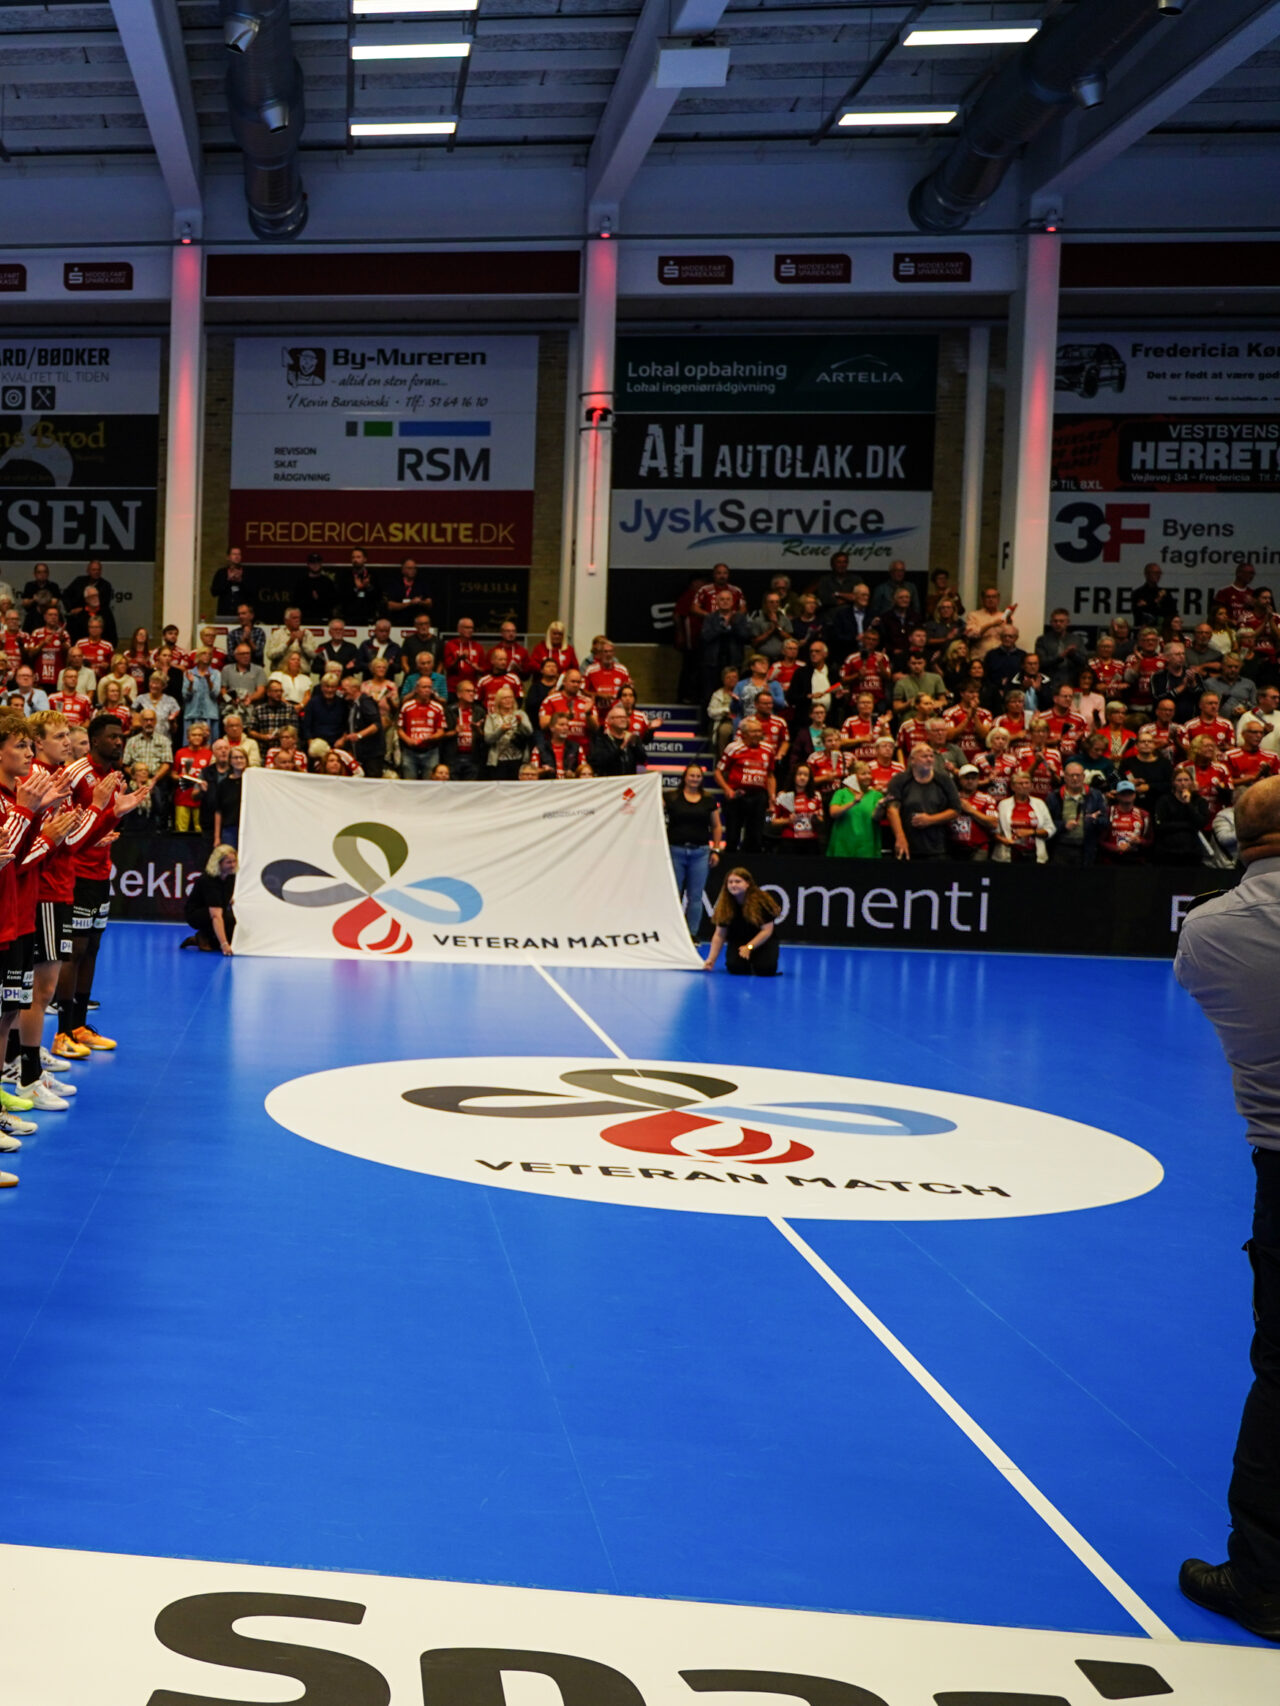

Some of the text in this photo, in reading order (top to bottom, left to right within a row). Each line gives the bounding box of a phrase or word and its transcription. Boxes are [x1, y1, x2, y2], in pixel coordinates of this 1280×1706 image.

[1131, 343, 1239, 358] Fredericia
[332, 349, 487, 370] By-Mureren
[2, 371, 52, 383] KVALITET
[56, 371, 72, 383] TIL
[76, 371, 110, 383] TIDEN
[628, 361, 788, 380] Lokal opbakning
[815, 371, 904, 384] ARTELIA
[1147, 371, 1167, 379] Det
[338, 373, 368, 387] altid
[370, 377, 381, 387] en
[385, 375, 407, 387] sten
[626, 381, 660, 393] Lokal
[299, 396, 328, 407] Kevin
[1168, 424, 1280, 439] VESTBYENS
[274, 447, 317, 456] REVISION
[638, 424, 907, 479] AH AUTOLAK.DK
[274, 460, 298, 469] SKAT
[397, 448, 490, 482] RSM
[1062, 479, 1077, 490] TIL
[1199, 472, 1250, 482] Fredericia
[620, 499, 885, 543] JyskService
[246, 521, 515, 544] FREDERICIASKILTE.DK
[1054, 501, 1150, 564] 3F
[1162, 518, 1235, 541] Byens
[781, 539, 832, 557] Rene
[1160, 546, 1280, 568] fagforenin
[432, 931, 660, 951] VETERAN MATCH
[475, 1159, 1012, 1198] VETERAN MATCH
